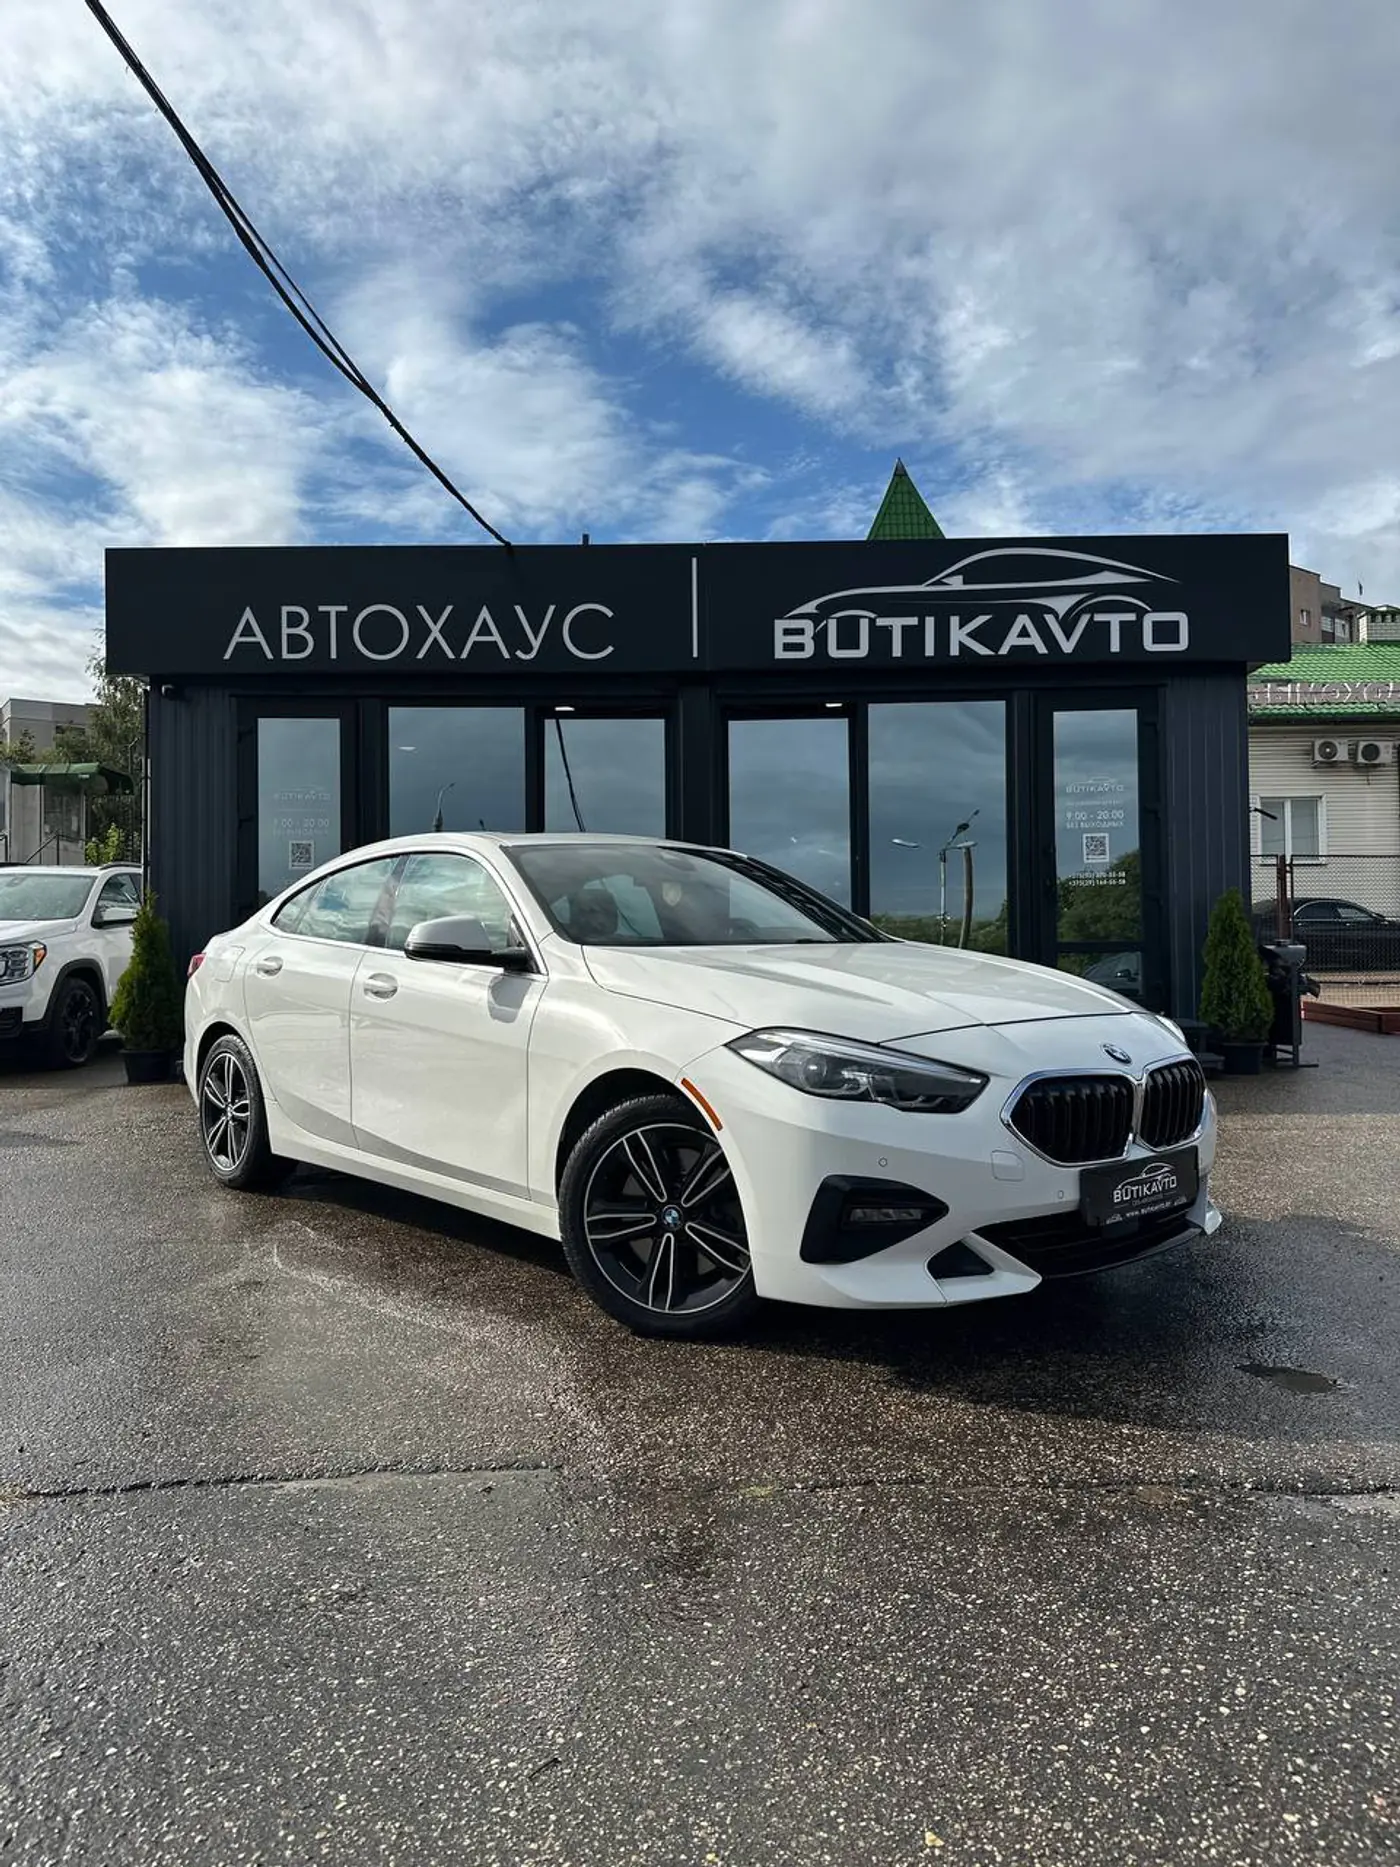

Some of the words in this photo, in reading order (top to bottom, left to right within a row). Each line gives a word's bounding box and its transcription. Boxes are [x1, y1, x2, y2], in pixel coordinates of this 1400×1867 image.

[223, 603, 615, 661] АВТОХАУС
[774, 611, 1189, 660] BUTIKAVTO
[1113, 1176, 1177, 1203] BUTIKAVTO
